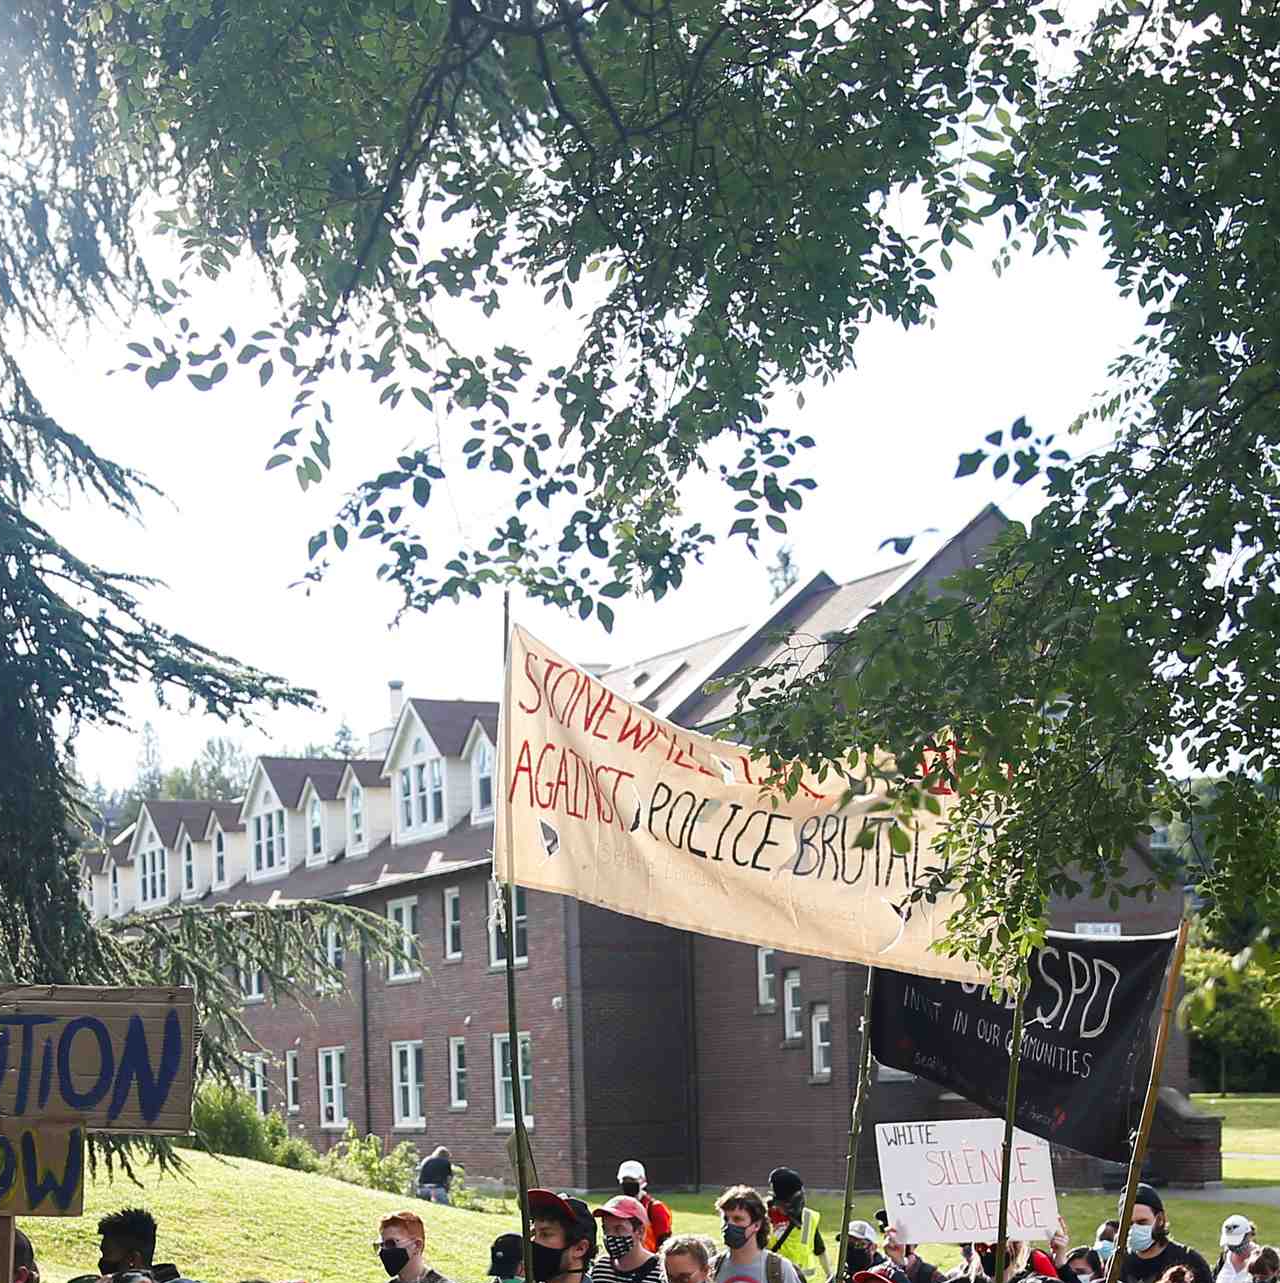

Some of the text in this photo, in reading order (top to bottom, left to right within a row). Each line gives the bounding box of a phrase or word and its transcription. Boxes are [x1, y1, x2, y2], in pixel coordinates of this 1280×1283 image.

[508, 740, 635, 832] AGAINST
[648, 783, 793, 872] POLICE
[1037, 946, 1121, 1038] SPD
[953, 1011, 968, 1035] IN
[977, 1018, 1001, 1050] OUR
[1005, 1029, 1093, 1079] CMMUNITIES
[882, 1124, 938, 1146] WHITE
[896, 1192, 917, 1207] IS
